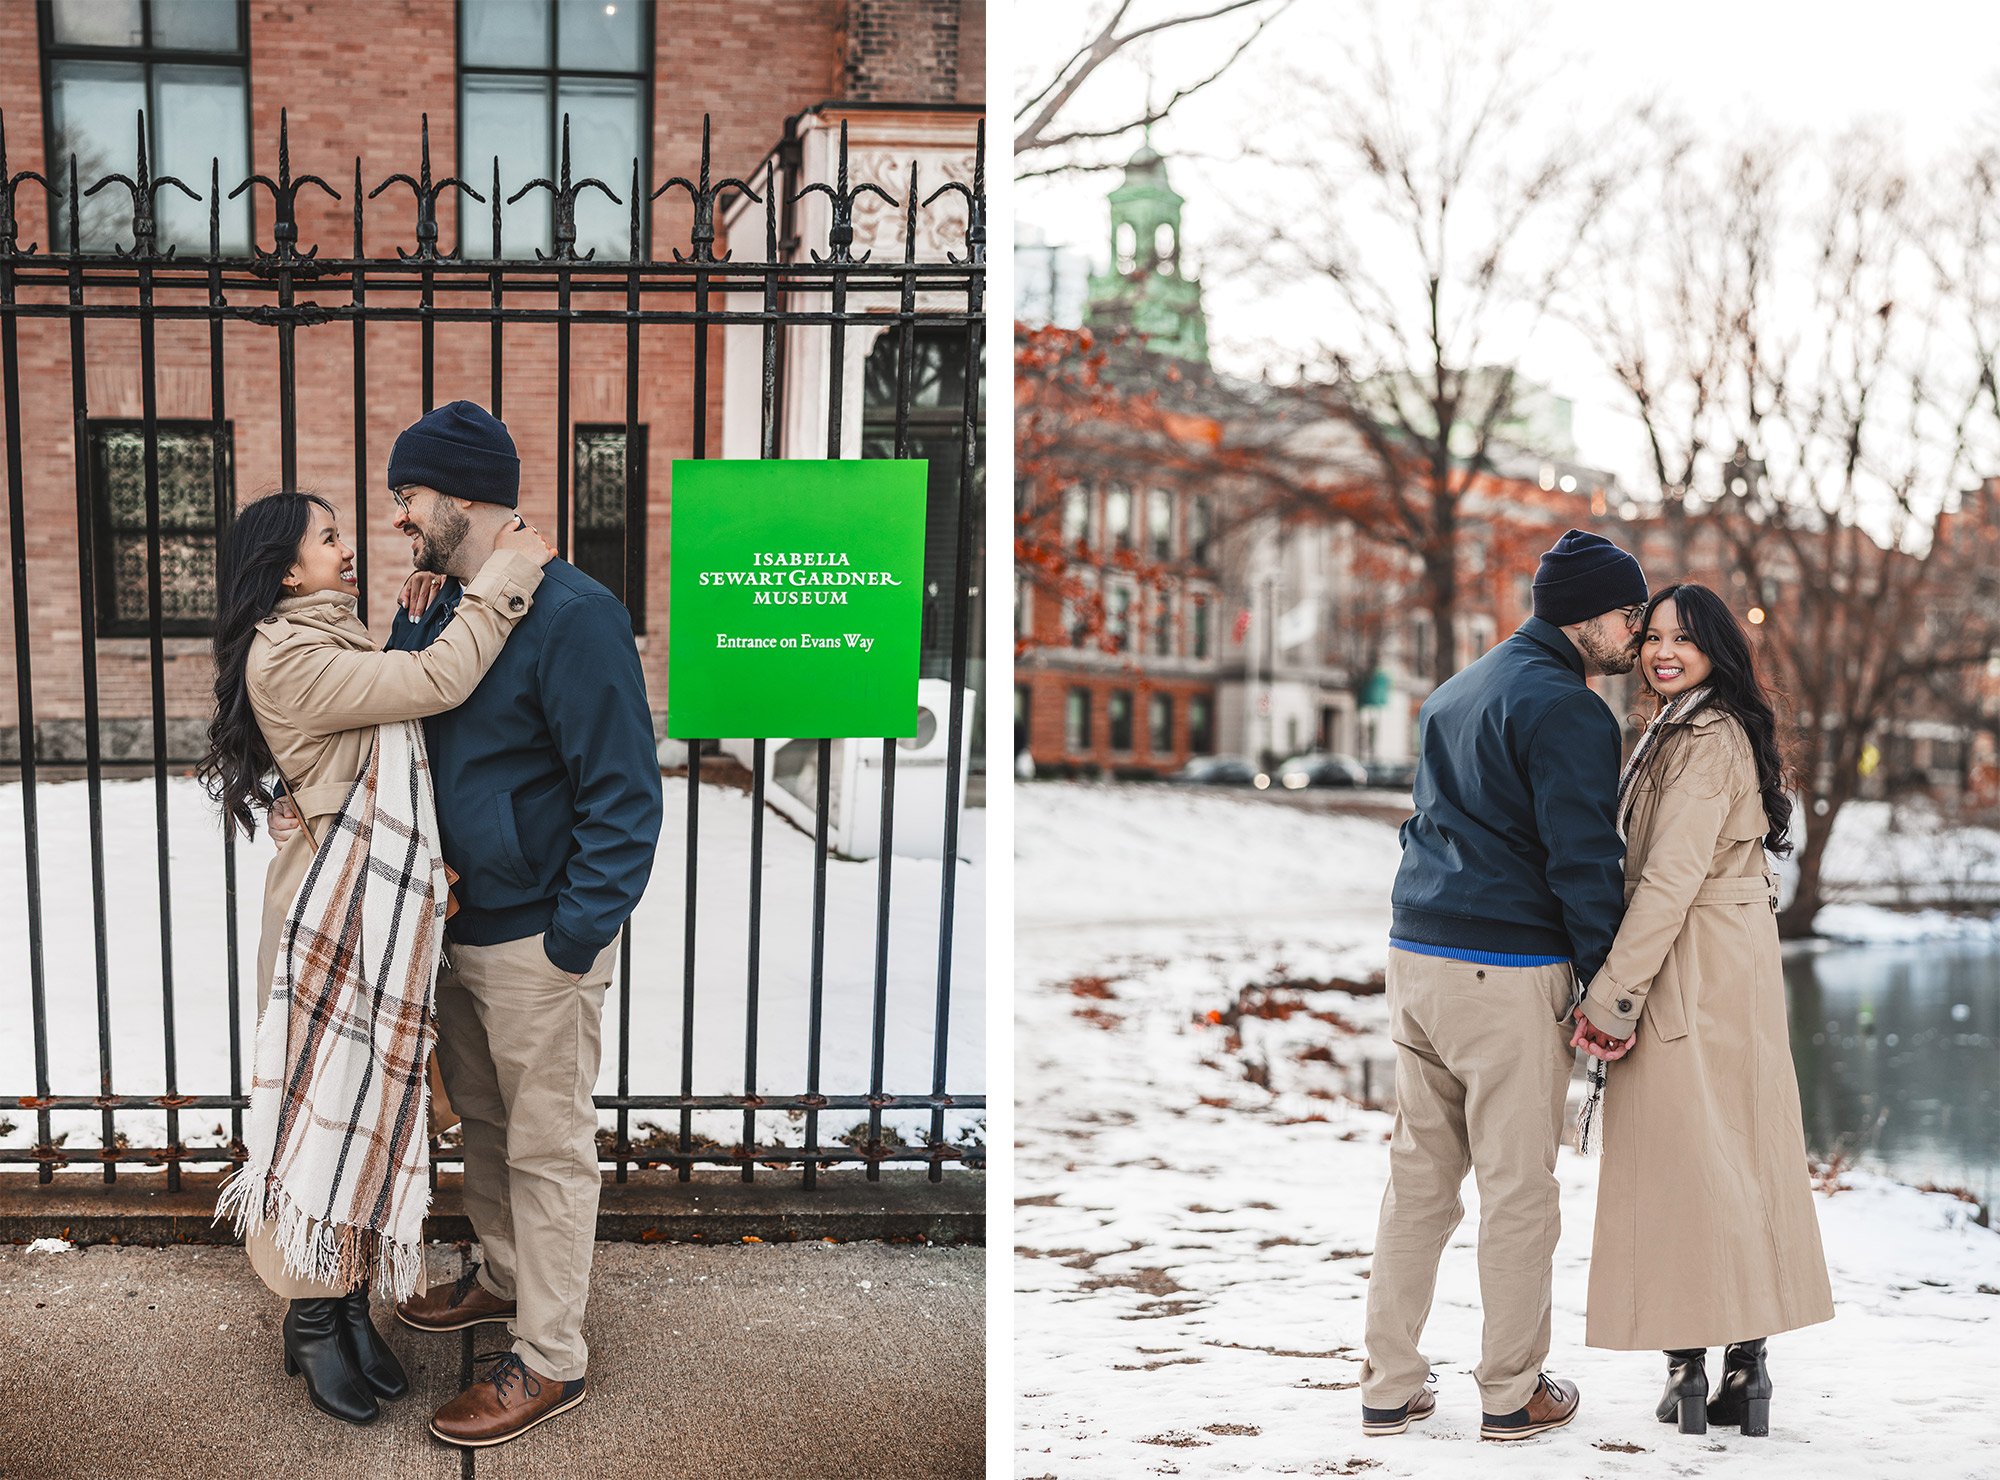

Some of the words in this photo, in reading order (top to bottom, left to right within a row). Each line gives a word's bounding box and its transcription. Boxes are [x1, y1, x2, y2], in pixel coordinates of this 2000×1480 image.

[753, 552, 850, 566] ISABELLA
[699, 571, 786, 586] STEWART
[788, 569, 902, 587] GARDNER
[753, 591, 848, 605] MUSEUM
[716, 633, 777, 649] Entrance
[780, 638, 798, 649] on
[800, 633, 841, 649] Evans
[843, 633, 875, 653] Way
